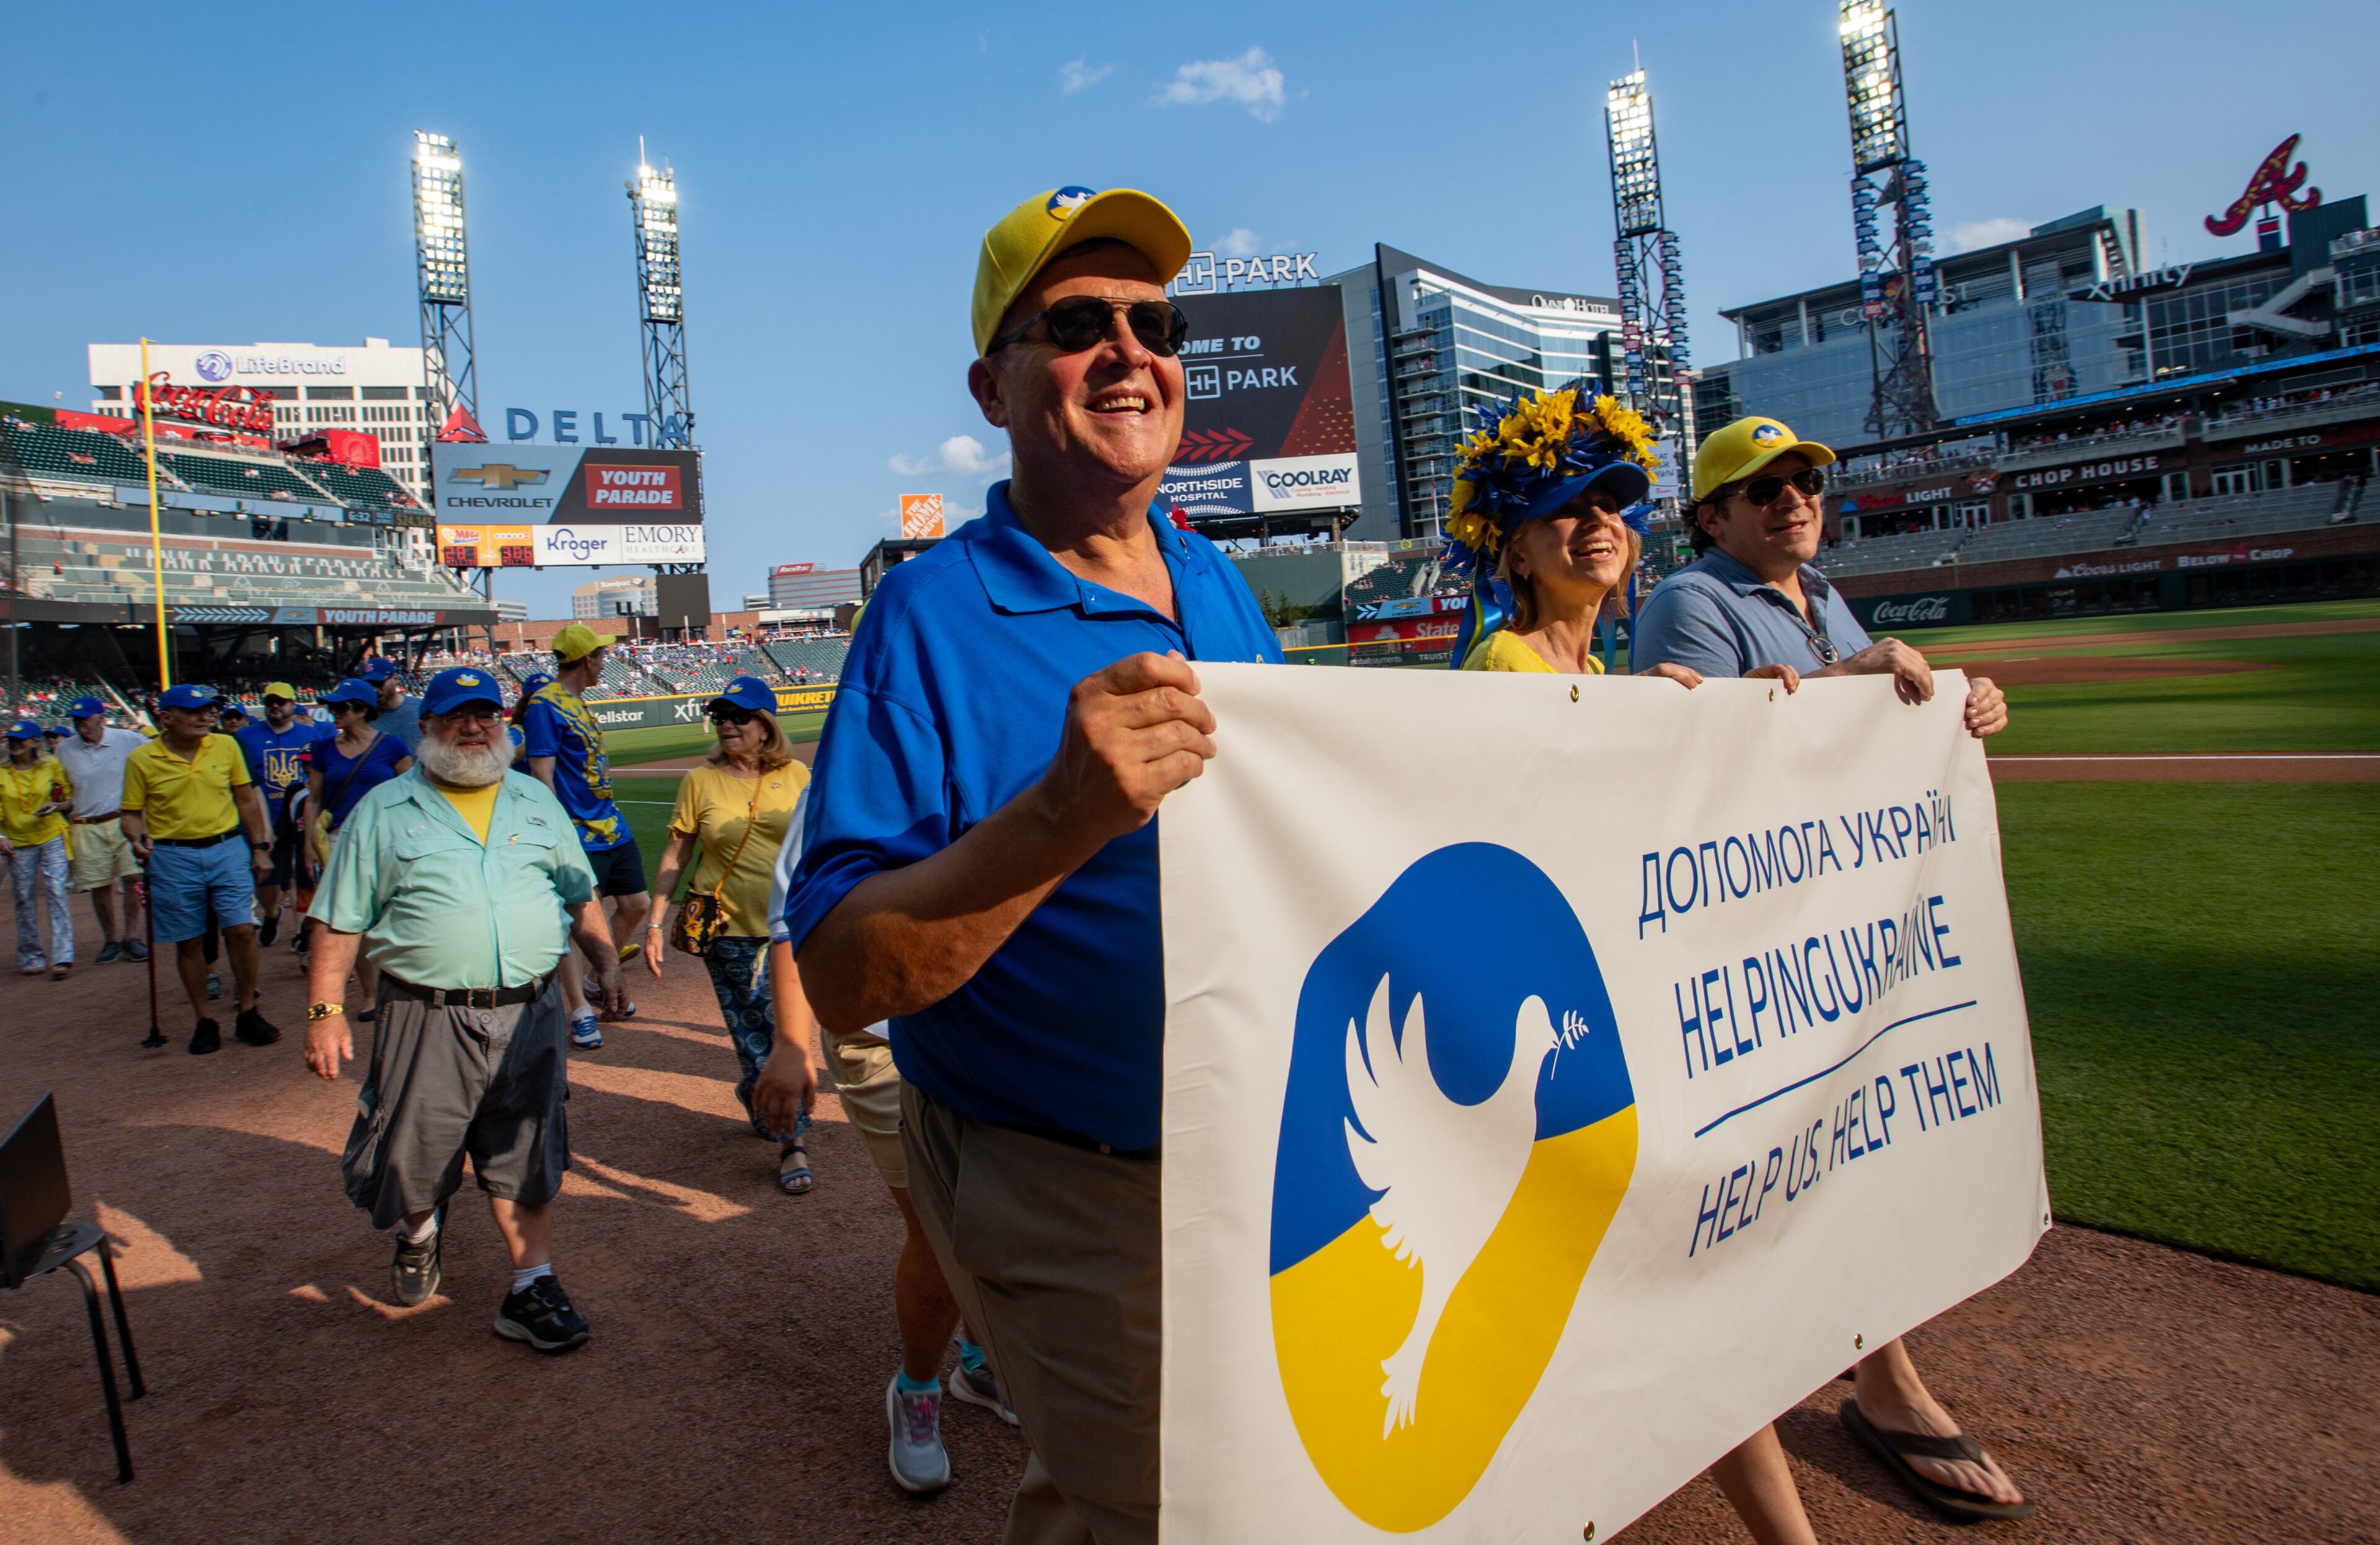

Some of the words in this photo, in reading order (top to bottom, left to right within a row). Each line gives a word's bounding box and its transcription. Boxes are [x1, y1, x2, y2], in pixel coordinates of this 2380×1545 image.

[1225, 252, 1320, 285] PARK
[1532, 294, 1563, 309] OMNI
[1177, 338, 1224, 354] OME
[1231, 336, 1261, 351] TO
[236, 356, 345, 374] LifeBrand
[1227, 366, 1298, 390] PARK
[506, 408, 689, 445] DELTA
[2244, 438, 2294, 454] MADE
[2297, 434, 2322, 446] TO
[601, 471, 666, 485] YOUTH
[1267, 468, 1352, 488] COOLRAY
[2016, 469, 2073, 488] CHOP
[2081, 456, 2159, 479] HOUSE
[1155, 478, 1243, 494] NORTHSIDE
[1906, 486, 1952, 503] LIGHT
[447, 496, 553, 508] CHEVROLET
[596, 489, 672, 504] PARADE
[1170, 491, 1227, 503] HOSPITAL
[348, 511, 371, 522] 6:32
[902, 495, 942, 537] HOME
[906, 500, 922, 516] THE
[919, 511, 943, 537] DEPOT
[625, 526, 698, 543] EMORY
[502, 546, 532, 559] 366
[547, 528, 607, 560] Kroger
[626, 545, 697, 553] HEALTHCARE
[2177, 553, 2231, 567] BELOW
[2249, 548, 2294, 561] CHOP
[2072, 563, 2116, 577] Coors
[2118, 560, 2162, 573] LIGHT
[325, 610, 377, 623] YOUTH
[379, 611, 436, 623] PARADE
[1873, 597, 1950, 623] Coca-Cola
[1416, 621, 1460, 639] State
[1418, 653, 1448, 661] TRUIST
[775, 690, 836, 706] UIKRET
[596, 710, 644, 724] ellstar
[1639, 819, 1843, 940] ДОПОМОГА
[1675, 895, 1962, 1080] HELPINGUKRAINE
[1689, 1147, 1783, 1258] HELP
[1829, 1075, 1895, 1171] HELP
[1900, 1042, 2001, 1132] THEM
